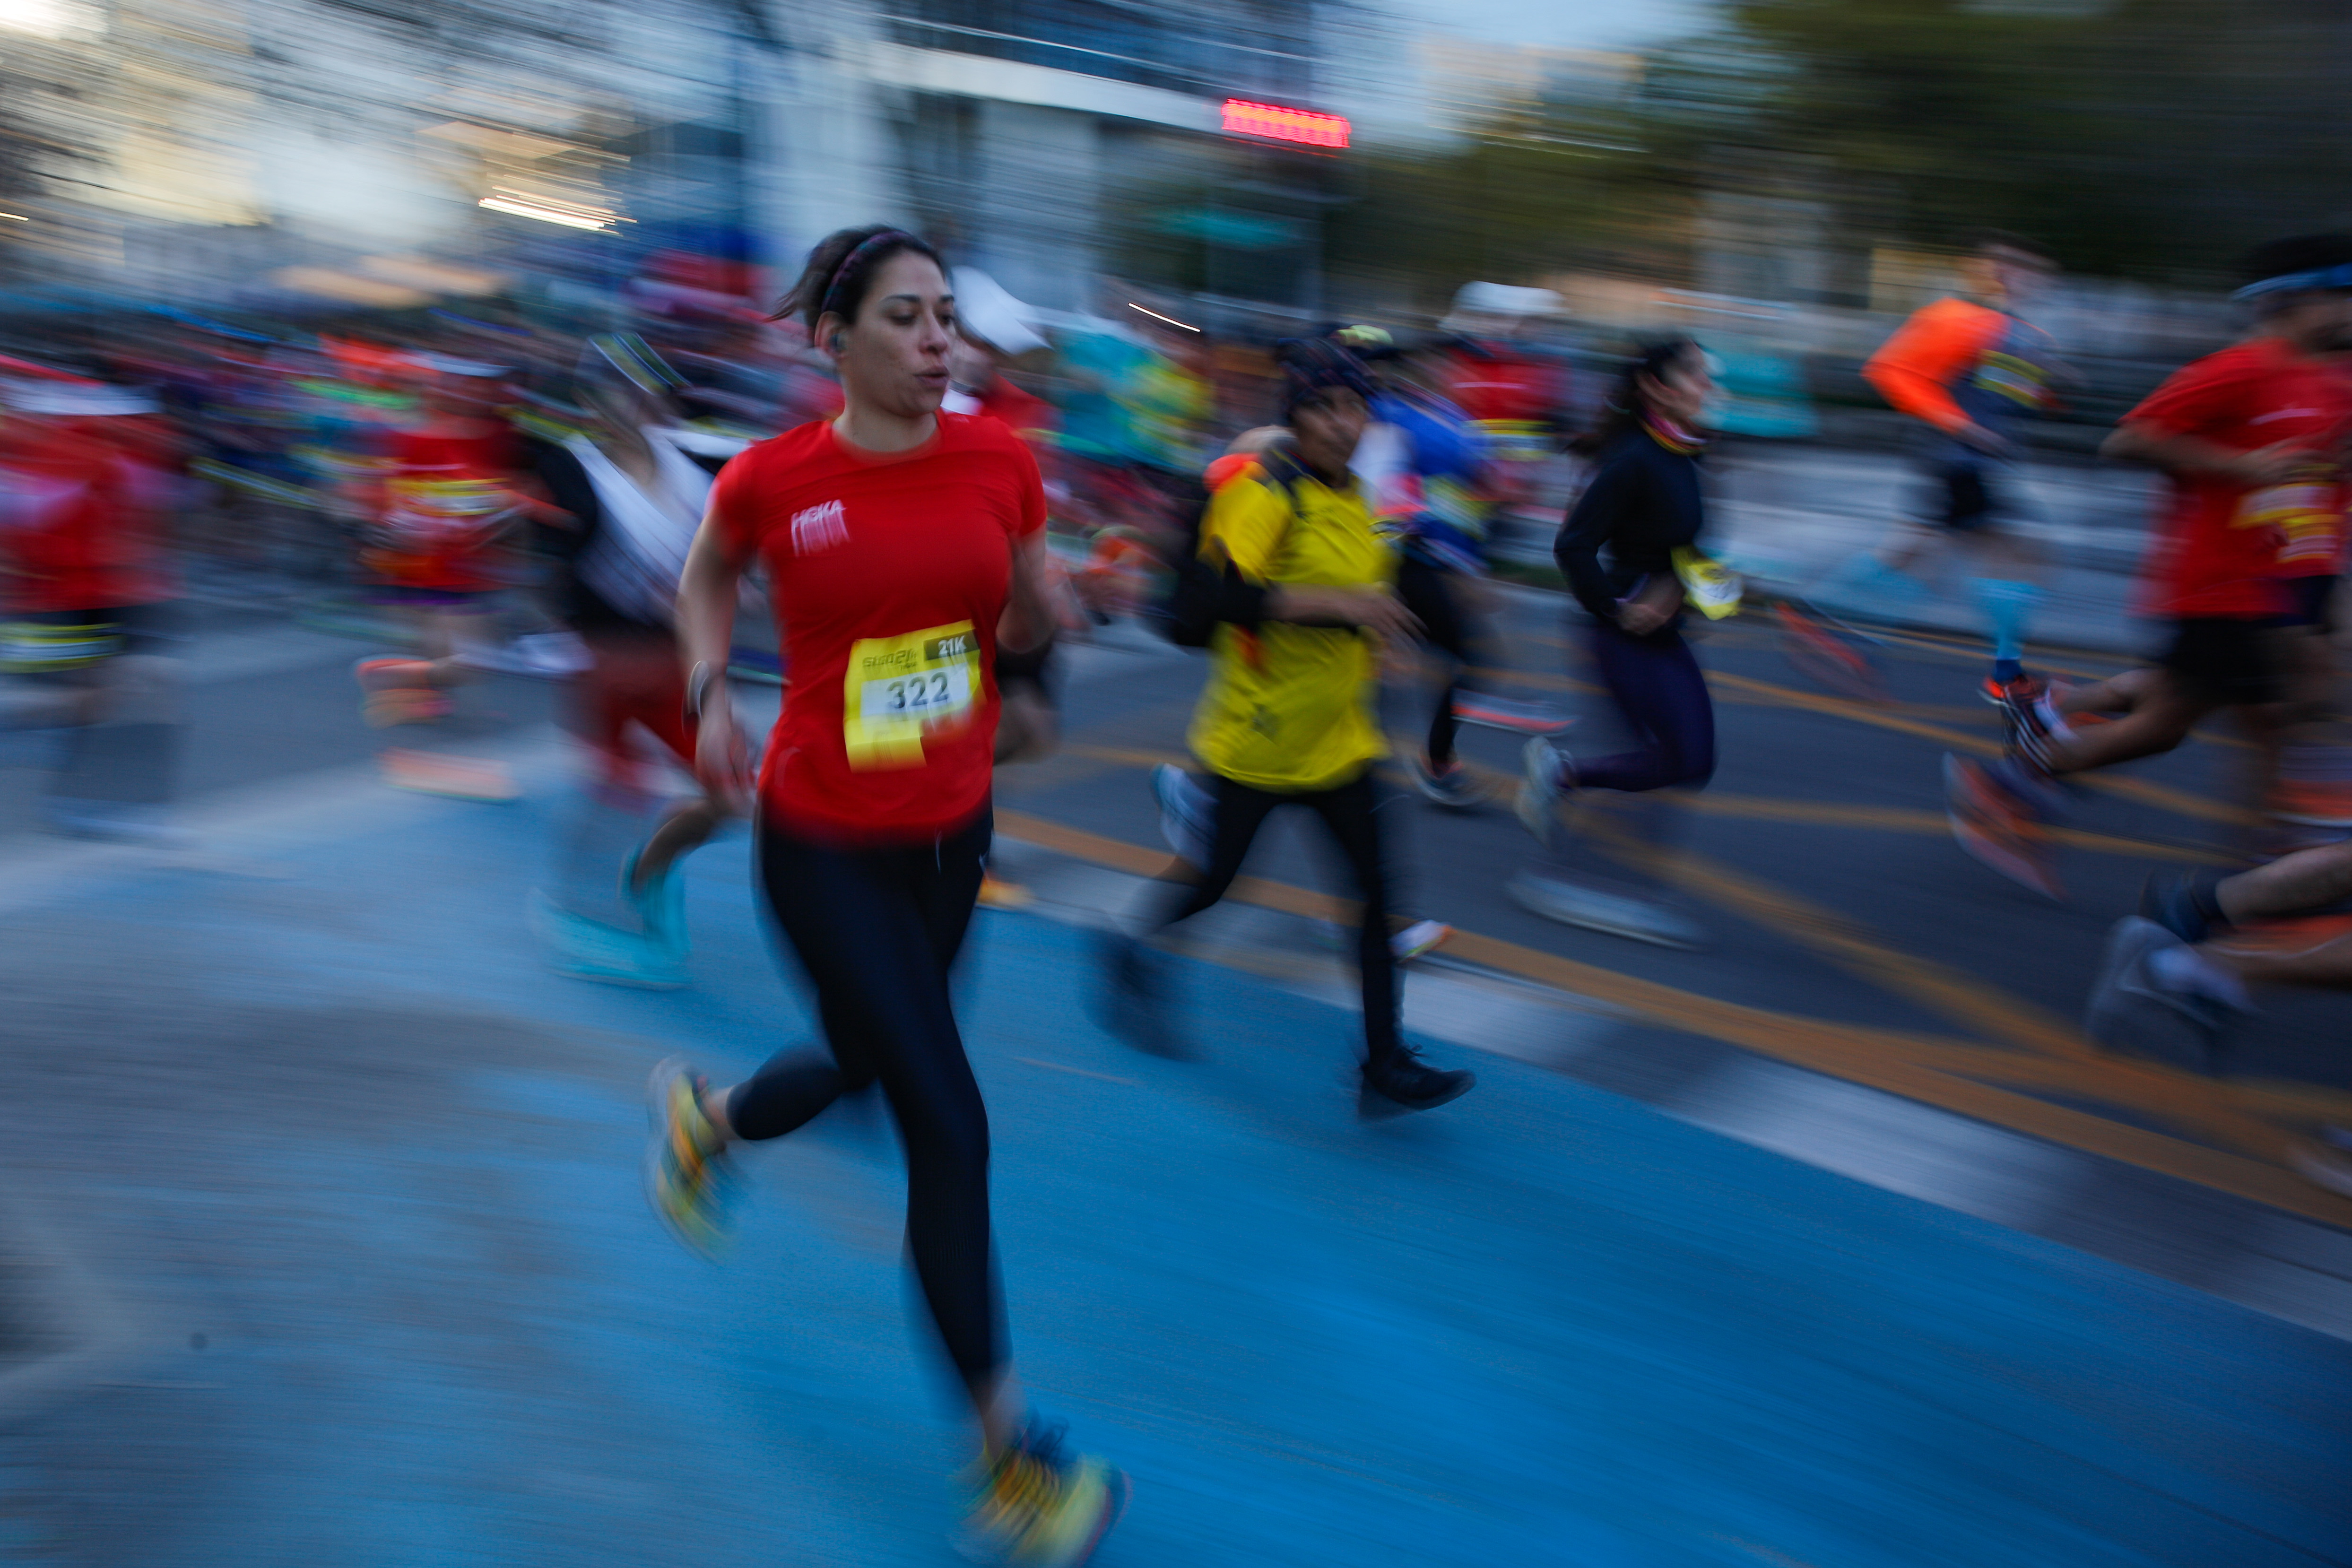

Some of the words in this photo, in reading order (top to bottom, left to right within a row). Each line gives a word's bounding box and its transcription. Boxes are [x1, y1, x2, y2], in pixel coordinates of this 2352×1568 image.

[790, 499, 848, 533] HOKA
[938, 635, 966, 658] 21K
[886, 671, 950, 709] 322
